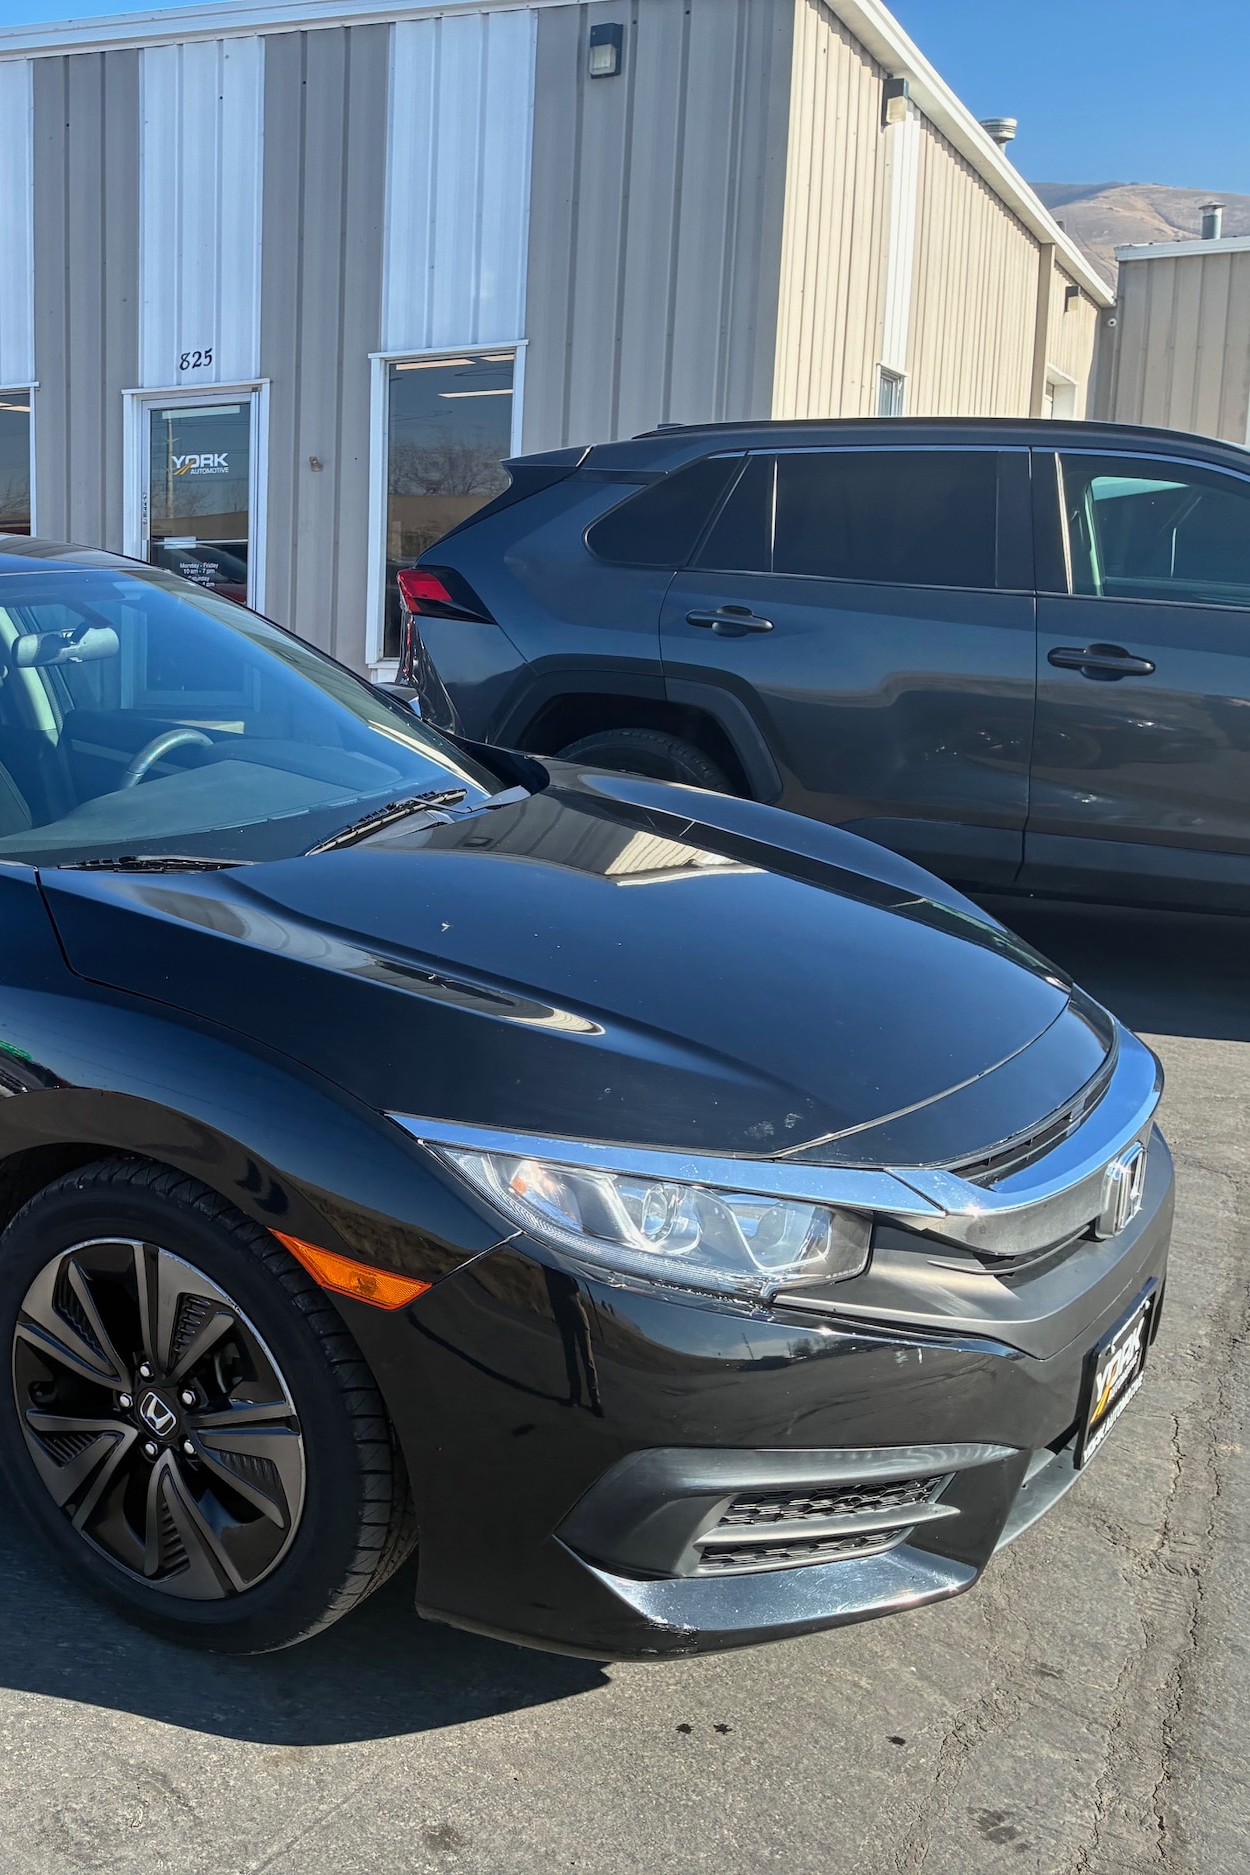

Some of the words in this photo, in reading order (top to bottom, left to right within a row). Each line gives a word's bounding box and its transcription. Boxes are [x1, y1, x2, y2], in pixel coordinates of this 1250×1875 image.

[180, 348, 212, 370] 825
[171, 453, 229, 469] YORK
[190, 467, 230, 475] AUTOMOTIVE
[1096, 1317, 1145, 1403] YORK
